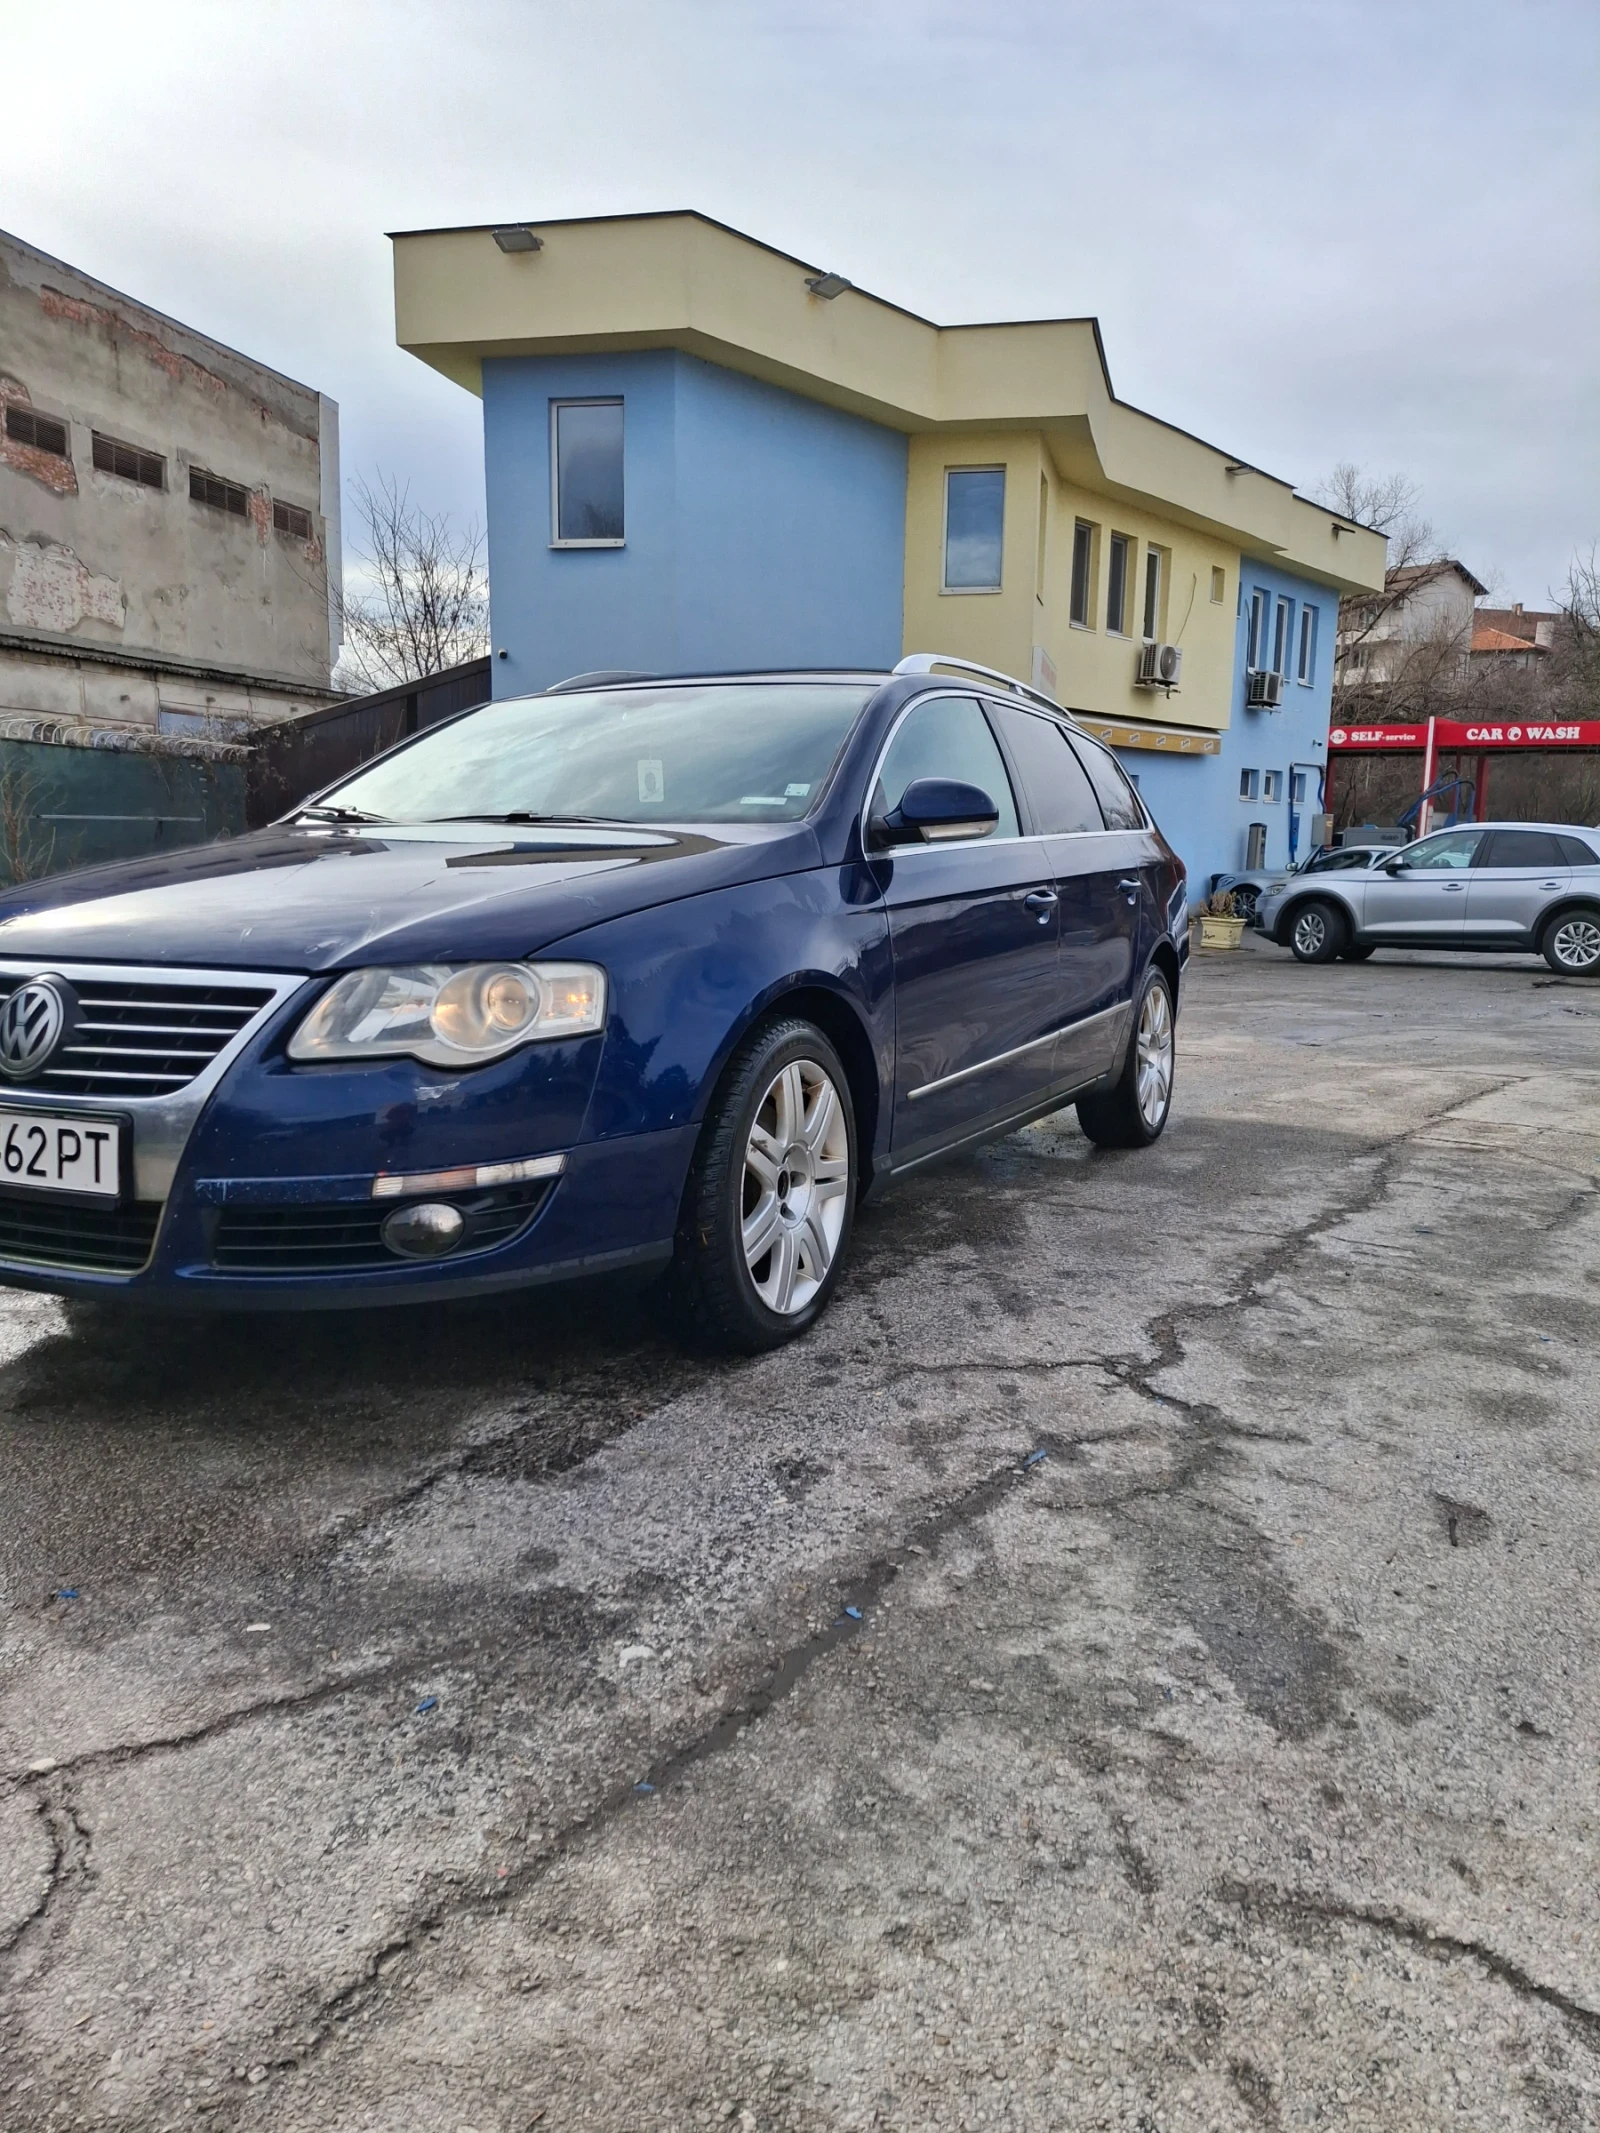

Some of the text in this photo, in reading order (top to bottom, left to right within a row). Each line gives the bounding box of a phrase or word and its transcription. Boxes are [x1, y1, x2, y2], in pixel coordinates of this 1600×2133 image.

[1351, 731, 1416, 741] SELF-service
[1466, 726, 1580, 740] CAR WASH
[2, 986, 58, 1066] VW
[0, 1123, 110, 1184] 62PT
